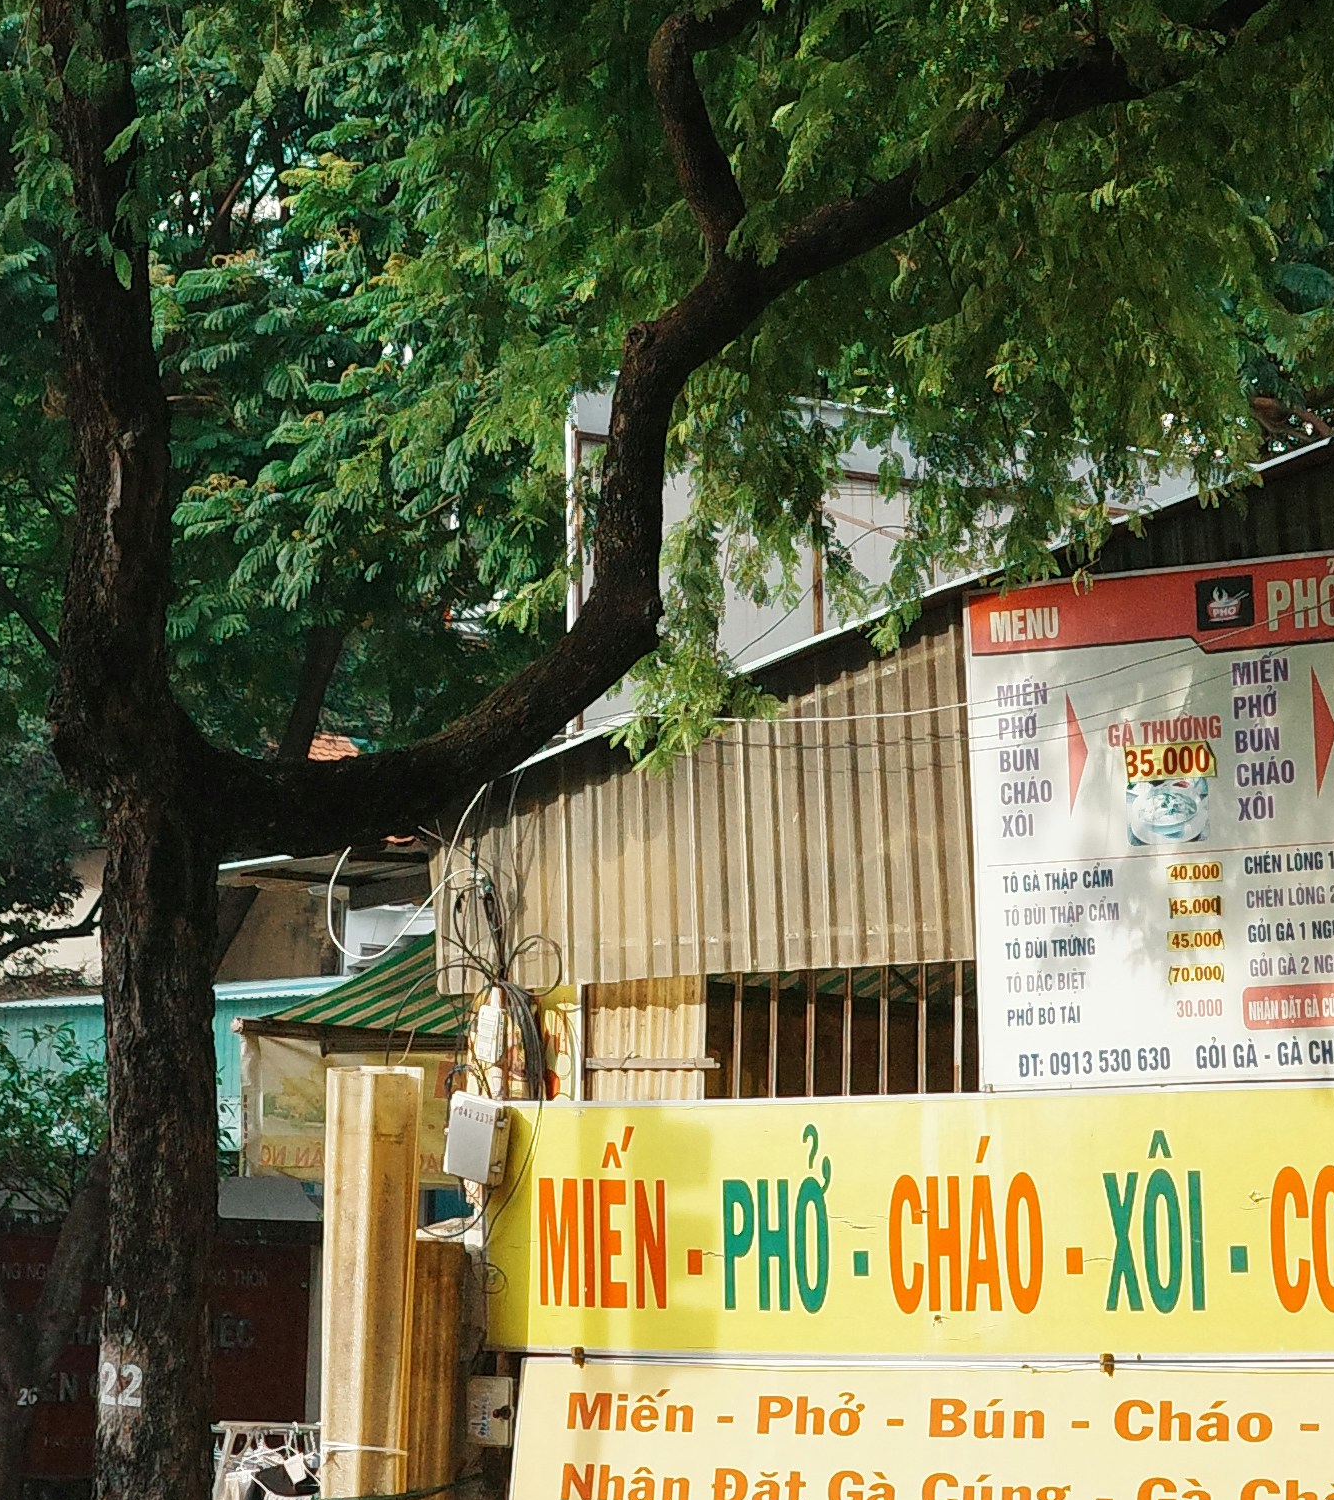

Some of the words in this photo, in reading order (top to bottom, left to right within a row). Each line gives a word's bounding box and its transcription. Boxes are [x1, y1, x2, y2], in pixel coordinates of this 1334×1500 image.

[989, 606, 1059, 643] MENU
[1231, 654, 1289, 686] MIẾN
[997, 676, 1048, 707] MIẾN
[1233, 687, 1277, 719] PHỞ
[999, 709, 1037, 740] PHỞ
[1108, 720, 1134, 748] GÀ
[1140, 713, 1222, 744] THƯỜNG
[1235, 722, 1279, 753] BÚN
[1000, 744, 1039, 773] BÚN
[1126, 744, 1210, 778] 35.000
[1236, 755, 1295, 788] CHÁO
[1001, 775, 1052, 806] CHÁO
[1238, 791, 1274, 822] XÔI
[1001, 811, 1034, 838] XÔI
[1170, 864, 1220, 881] 40.000
[1244, 848, 1282, 875] CHÉN
[1286, 847, 1323, 872] LÒNG
[1003, 871, 1018, 893] TÔ
[1023, 869, 1040, 891] GÀ
[1246, 883, 1284, 909] CHÉN
[1288, 881, 1325, 906] LÒNG
[1004, 904, 1019, 927] TÔ
[1024, 903, 1046, 926] ĐÙI
[1171, 931, 1221, 949] 45.000
[1248, 917, 1271, 944] GỎI
[1276, 918, 1295, 942] GÀ
[1005, 938, 1020, 960] TÔ
[1025, 935, 1047, 960] ĐÙI
[1172, 966, 1221, 983] 70.000
[1249, 951, 1273, 977] GỎI
[1278, 952, 1296, 976] GÀ
[1006, 971, 1022, 994] TÔ
[1007, 1001, 1034, 1027] PHỞ
[1039, 1001, 1055, 1025] BÒ
[1060, 1001, 1081, 1024] TÁI
[1176, 999, 1223, 1018] 30.000
[1305, 994, 1320, 1018] GÀ
[1049, 1050, 1093, 1076] 0913
[1099, 1048, 1132, 1074] 530
[1137, 1046, 1171, 1072] 630
[1196, 1037, 1227, 1070] GỎI
[1233, 1038, 1258, 1069] GÀ
[1277, 1035, 1303, 1067] GÀ
[538, 1125, 668, 1310] MIẾN
[723, 1123, 832, 1314] PHỞ
[888, 1135, 1045, 1315] CHÁO
[1102, 1129, 1207, 1314] XÔI
[17, 1387, 38, 1406] 26
[101, 1361, 143, 1408] 22
[566, 1387, 695, 1433] Miến
[756, 1391, 865, 1437] Phở
[928, 1397, 1046, 1439] Bún
[1114, 1399, 1273, 1443] Cháo
